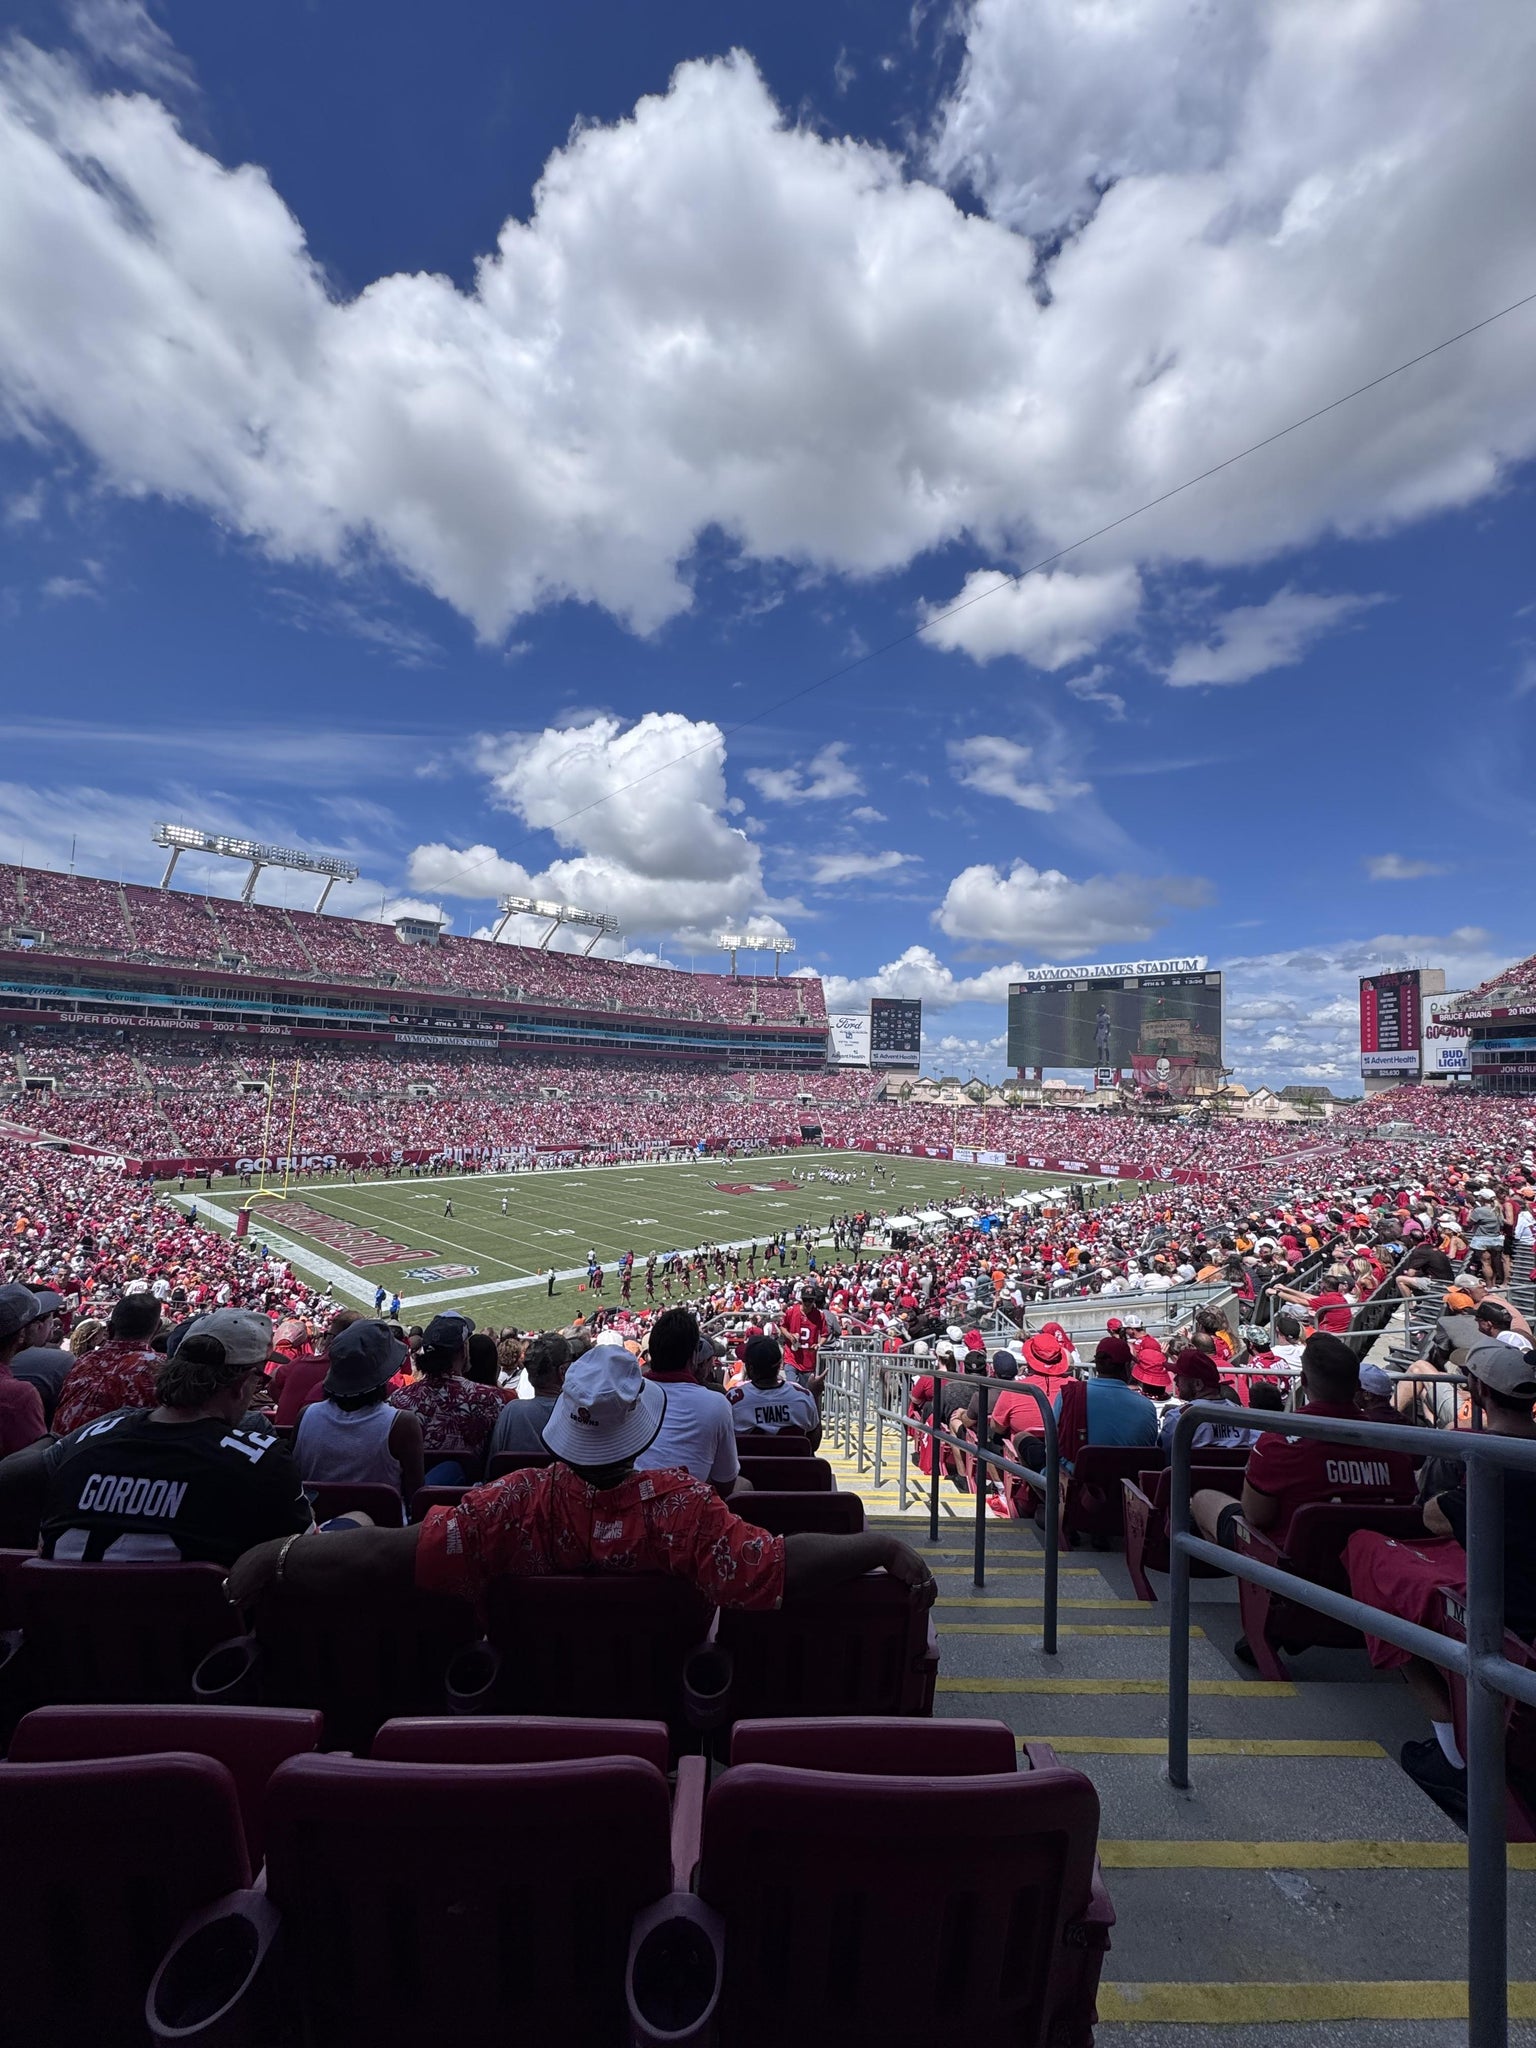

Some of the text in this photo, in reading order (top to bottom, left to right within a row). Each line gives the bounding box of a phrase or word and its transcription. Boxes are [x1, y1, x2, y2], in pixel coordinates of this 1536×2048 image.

[1028, 959, 1199, 981] RAYMOND JAMES STADIUM
[272, 1005, 300, 1014] Corona
[1439, 1010, 1492, 1021] BRUCE ARIANS
[1508, 1008, 1518, 1016] 20
[60, 1013, 201, 1030] SUPER BOWL CHAMPIONS
[212, 1023, 235, 1032] 2002
[835, 1017, 863, 1029] Ford
[260, 1026, 281, 1034] 2020
[1426, 1026, 1440, 1039] GO
[396, 1034, 498, 1047] RAYMOND JAMES STADIUM
[1370, 1056, 1417, 1064] AdventHealth
[1442, 1050, 1463, 1059] BUD
[1438, 1059, 1468, 1067] LIGHT
[728, 1139, 744, 1148] GO
[235, 1155, 337, 1172] GO BUCS
[755, 1405, 790, 1424] EVANS
[1326, 1459, 1391, 1486] GODWIN
[78, 1473, 188, 1519] GORDON
[1454, 1603, 1466, 1625] M
